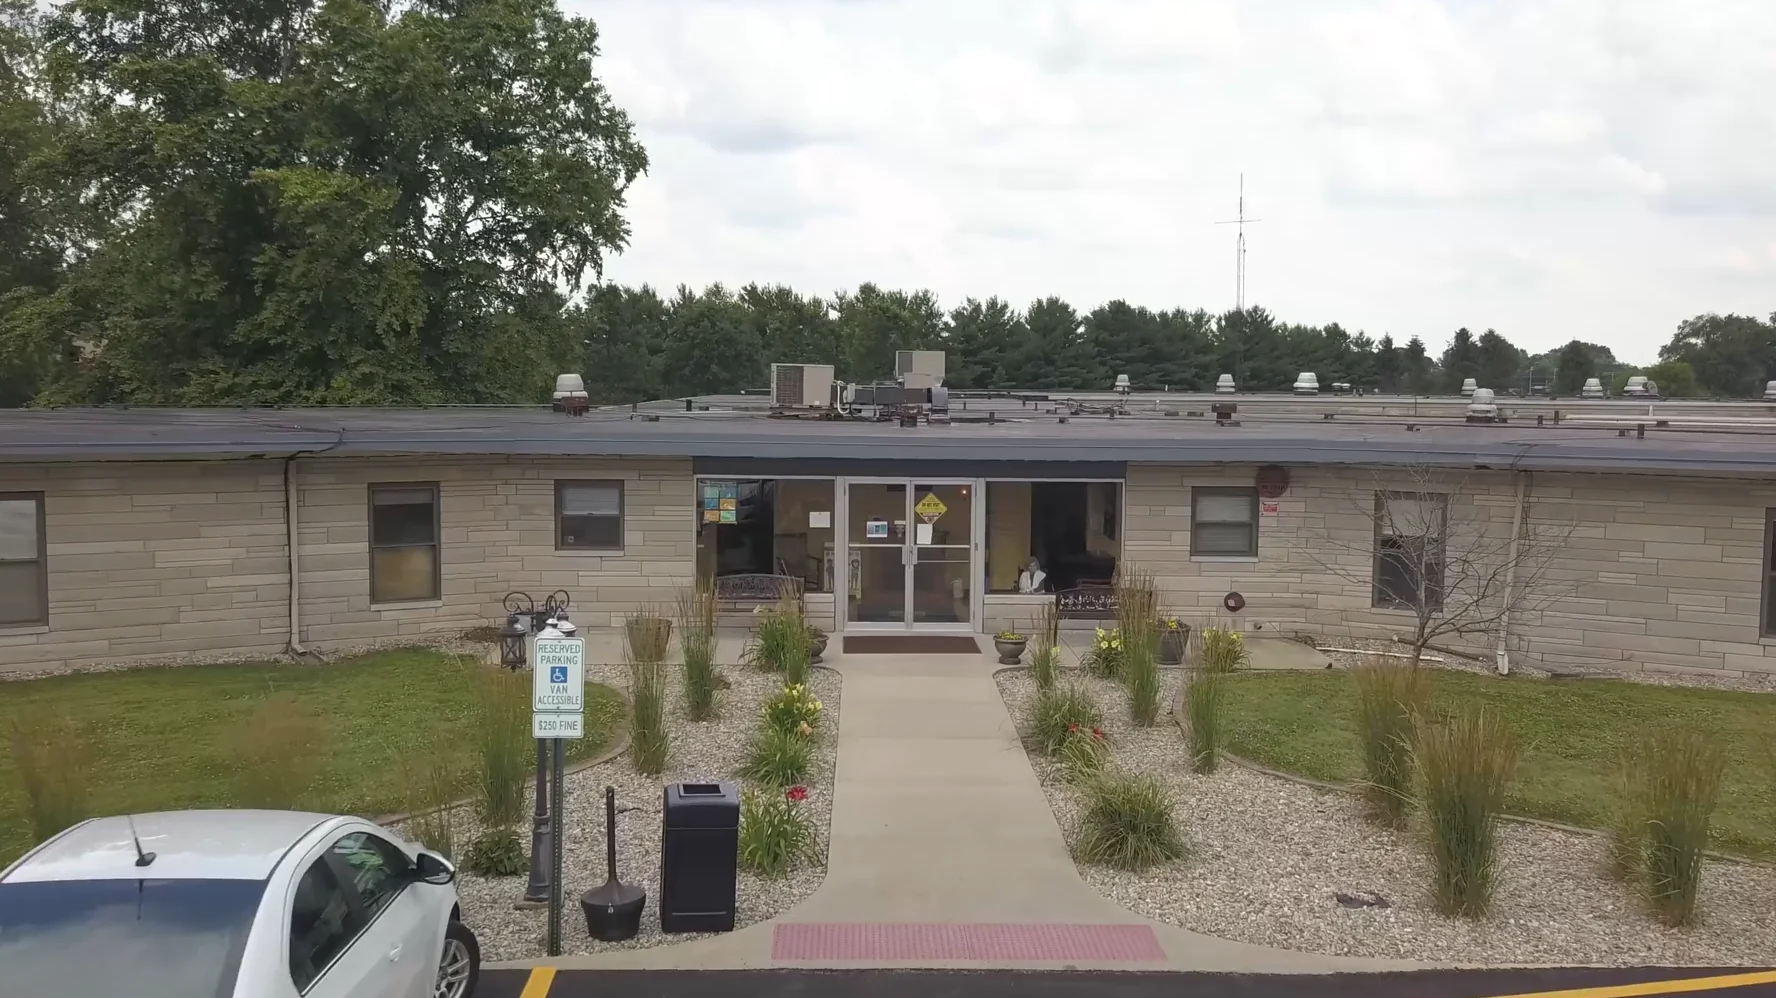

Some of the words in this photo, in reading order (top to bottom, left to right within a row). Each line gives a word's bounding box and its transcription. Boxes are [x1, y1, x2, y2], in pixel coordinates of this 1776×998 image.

[538, 644, 580, 653] RESERVED
[540, 656, 578, 665] PARKING
[550, 685, 568, 694] VAN
[537, 696, 579, 705] ACCESSIBLE
[538, 721, 557, 730] $250
[560, 721, 578, 730] FINE
